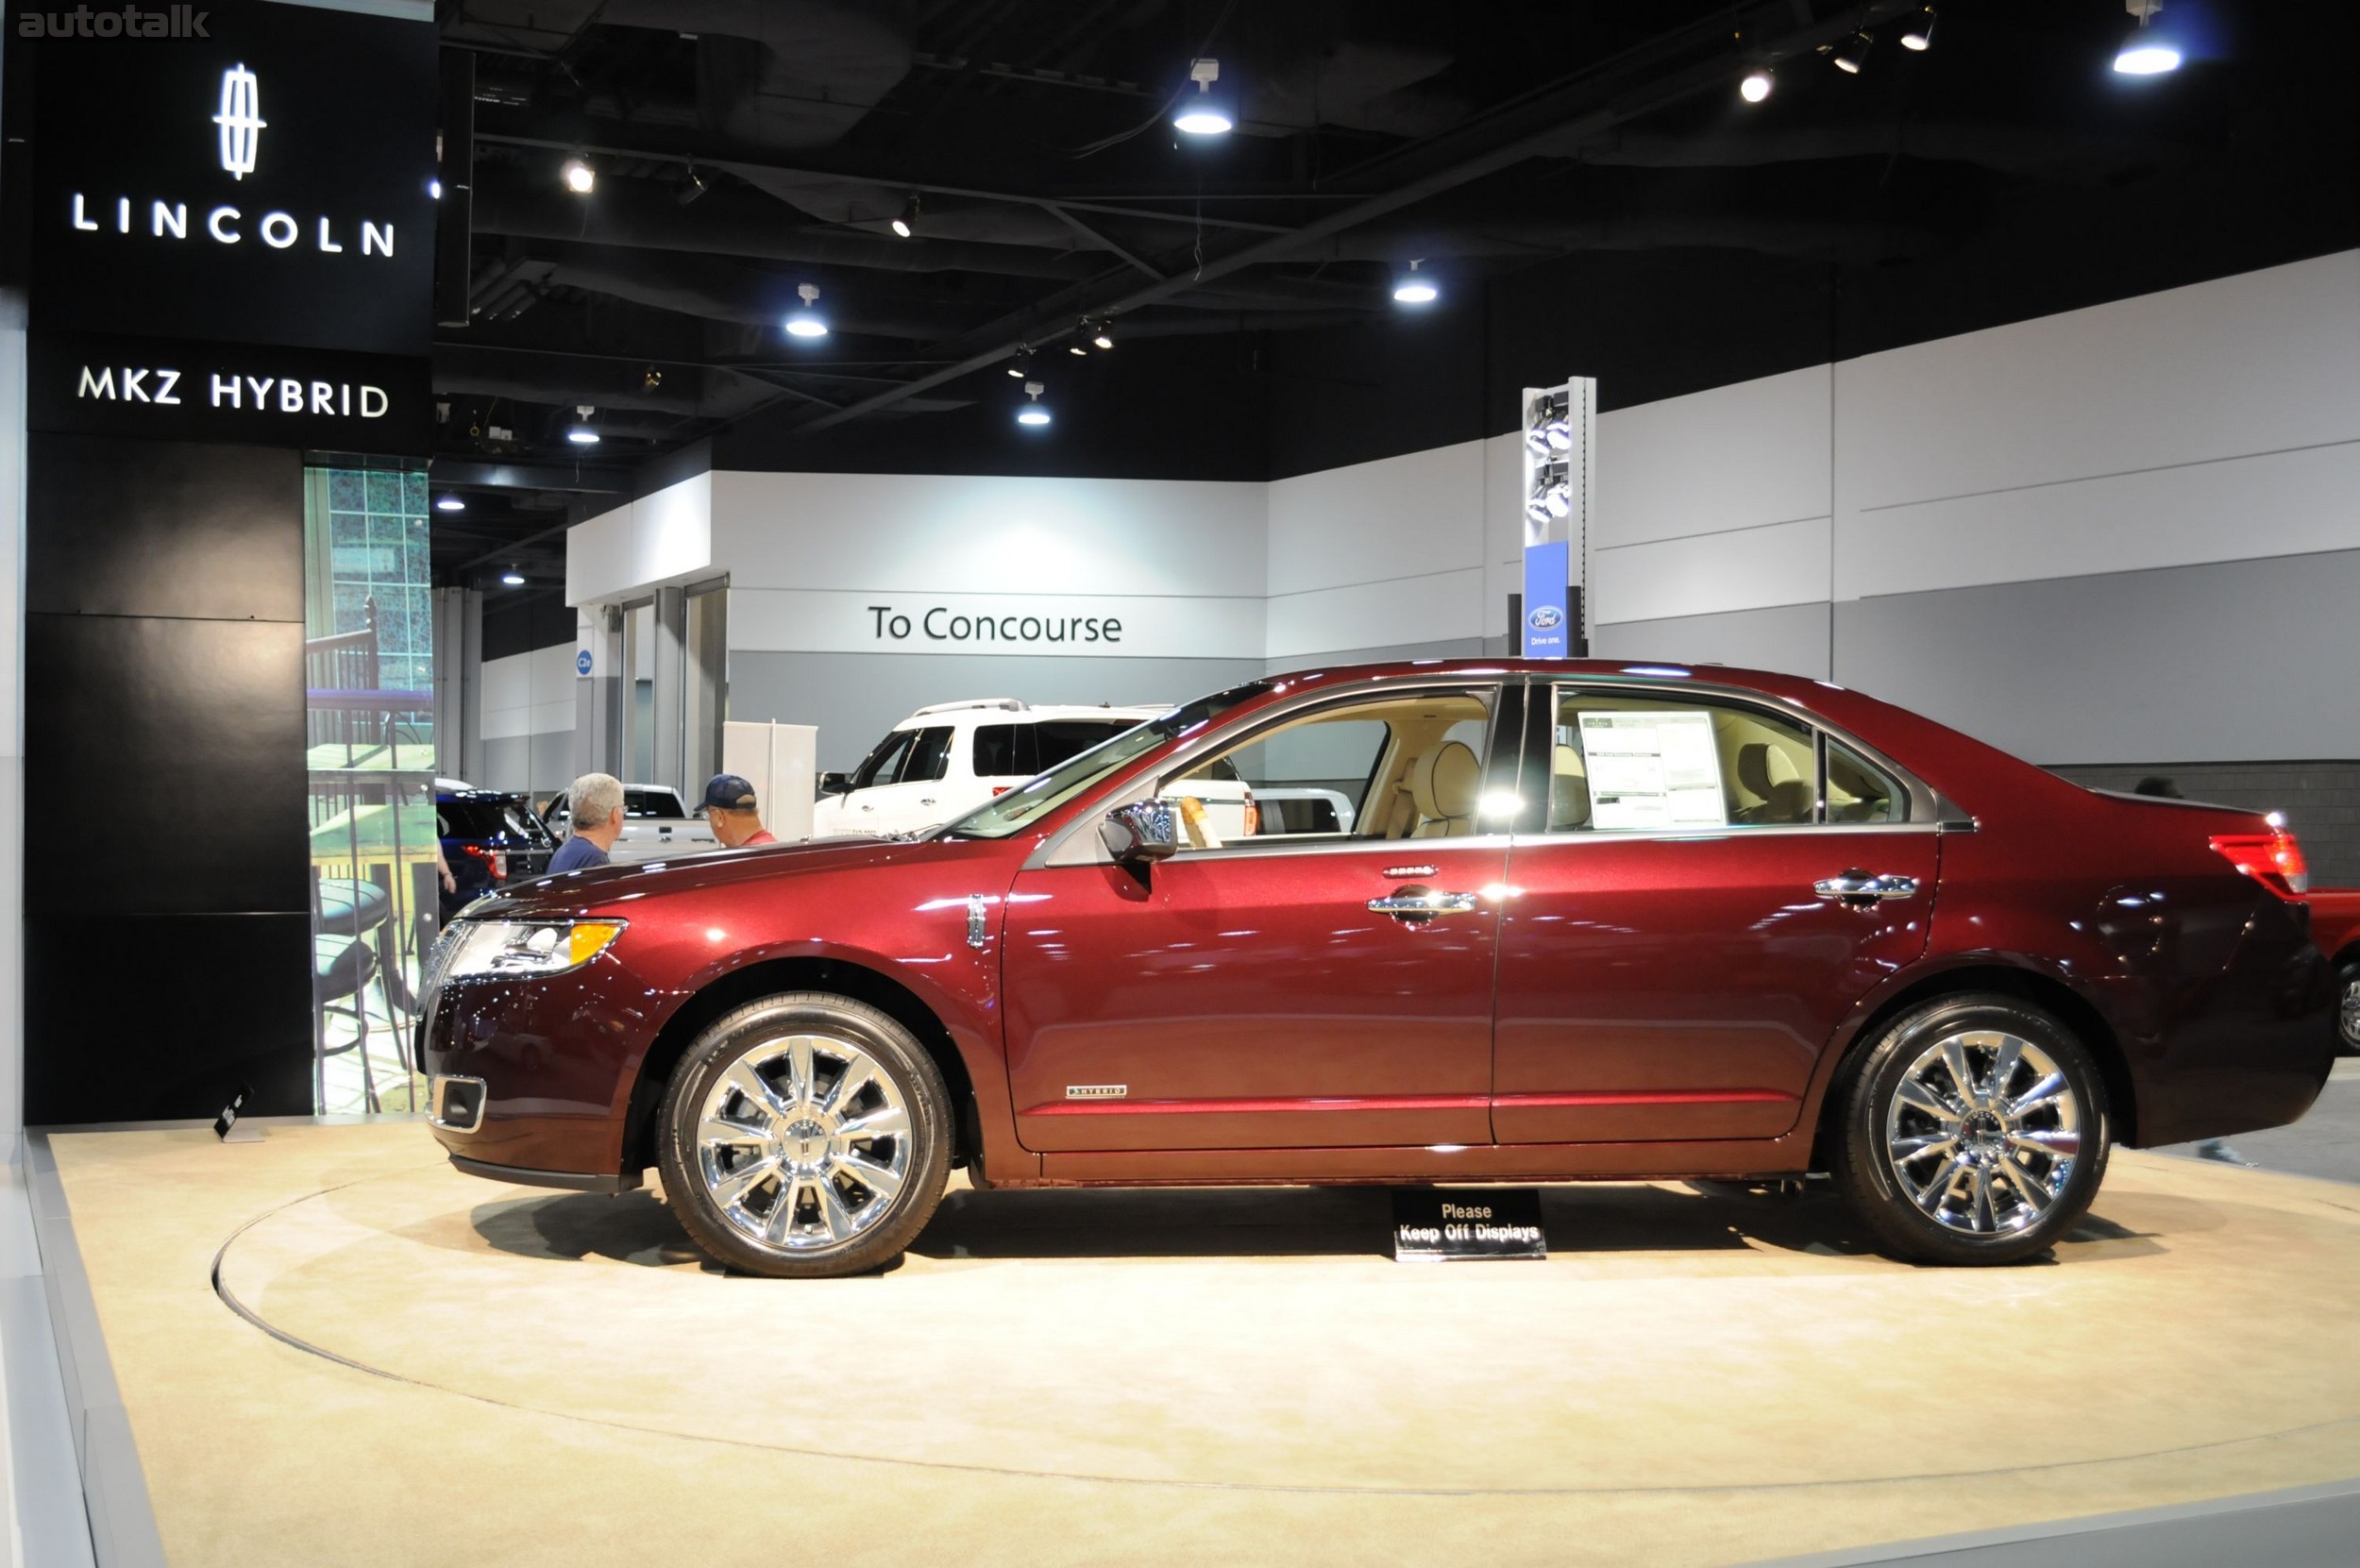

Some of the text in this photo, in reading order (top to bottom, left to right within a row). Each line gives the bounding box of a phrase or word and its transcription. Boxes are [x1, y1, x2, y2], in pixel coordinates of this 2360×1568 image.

[73, 193, 395, 258] LINCOLN
[77, 365, 389, 418] MKZ HYBRID
[868, 606, 1122, 643] To Concourse
[1534, 609, 1557, 626] Ford
[1530, 637, 1546, 646] Drive
[1441, 1203, 1492, 1219] Please
[1400, 1223, 1541, 1242] Keep Off Displays
